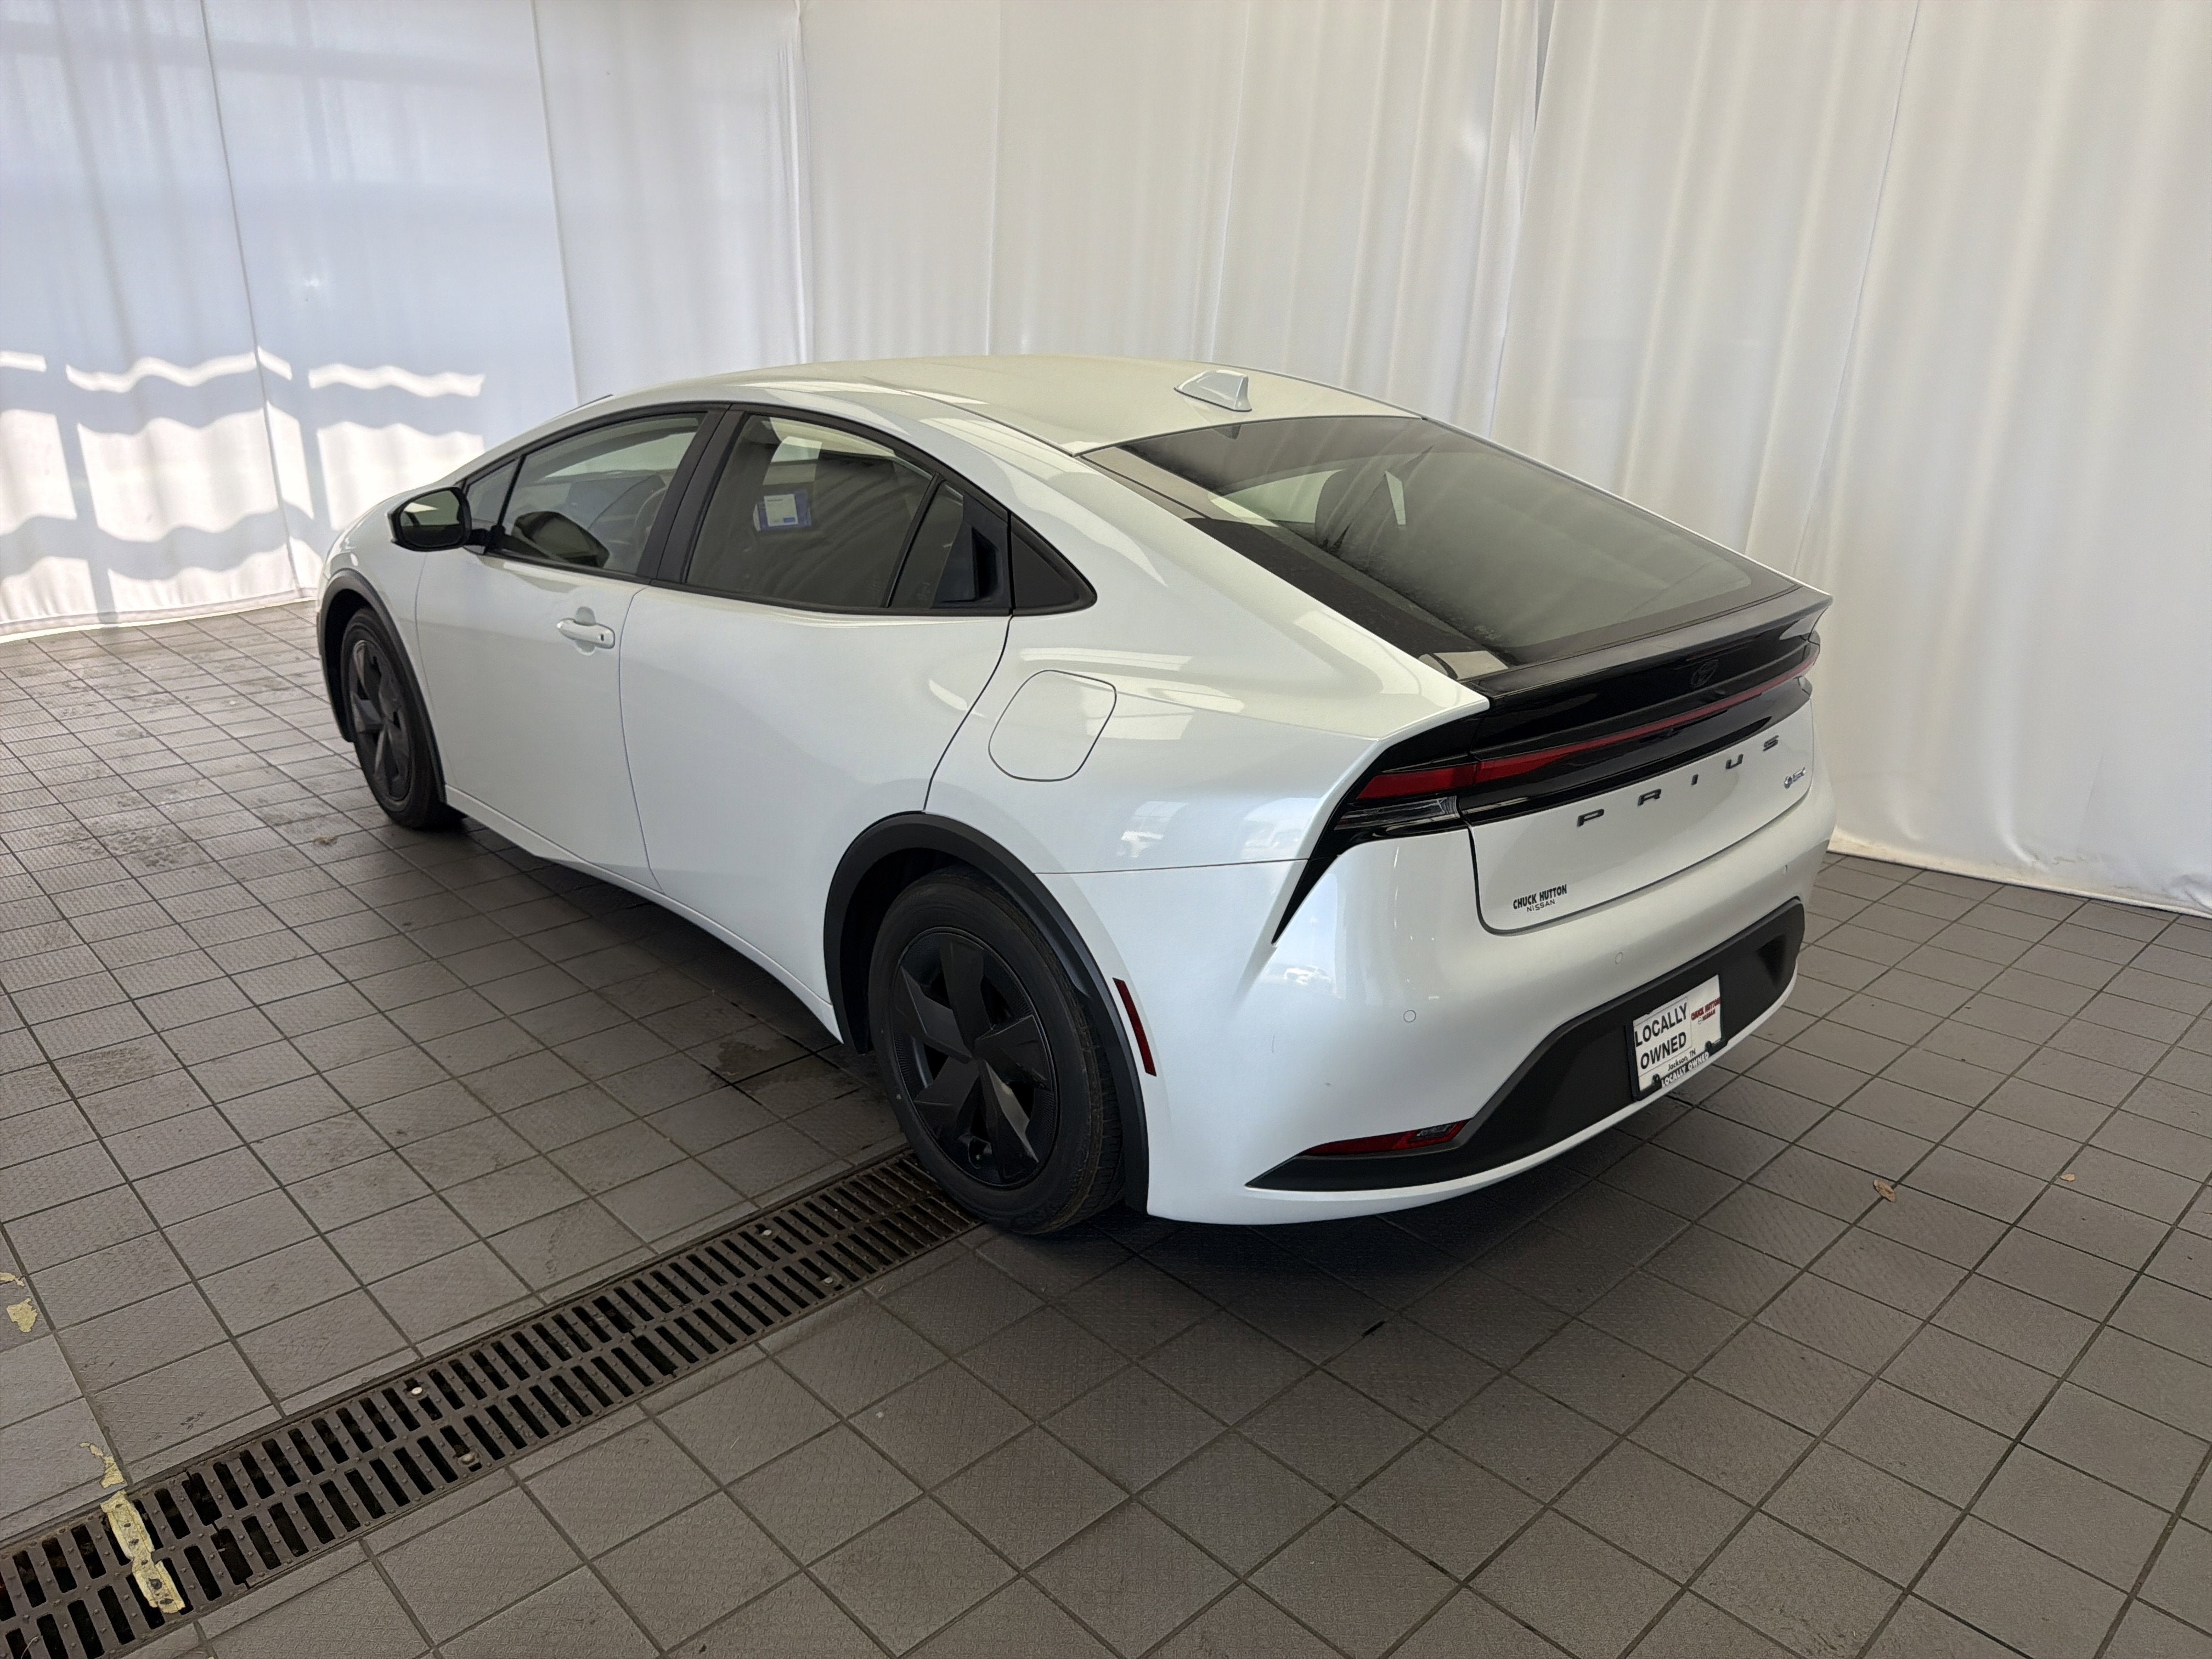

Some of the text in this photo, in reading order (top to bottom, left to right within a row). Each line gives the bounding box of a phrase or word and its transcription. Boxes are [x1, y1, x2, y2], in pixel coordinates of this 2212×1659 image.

[1577, 735, 1779, 827] PRIUS
[1513, 884, 1567, 910] CHUCK HUTTON
[1526, 899, 1555, 912] NISSAN
[1634, 1002, 1687, 1047] LOCALLY
[1640, 1031, 1686, 1069] OWNED
[1668, 1047, 1696, 1071] Jackson, TN
[1661, 1051, 1709, 1088] LOCALLY OWNED
